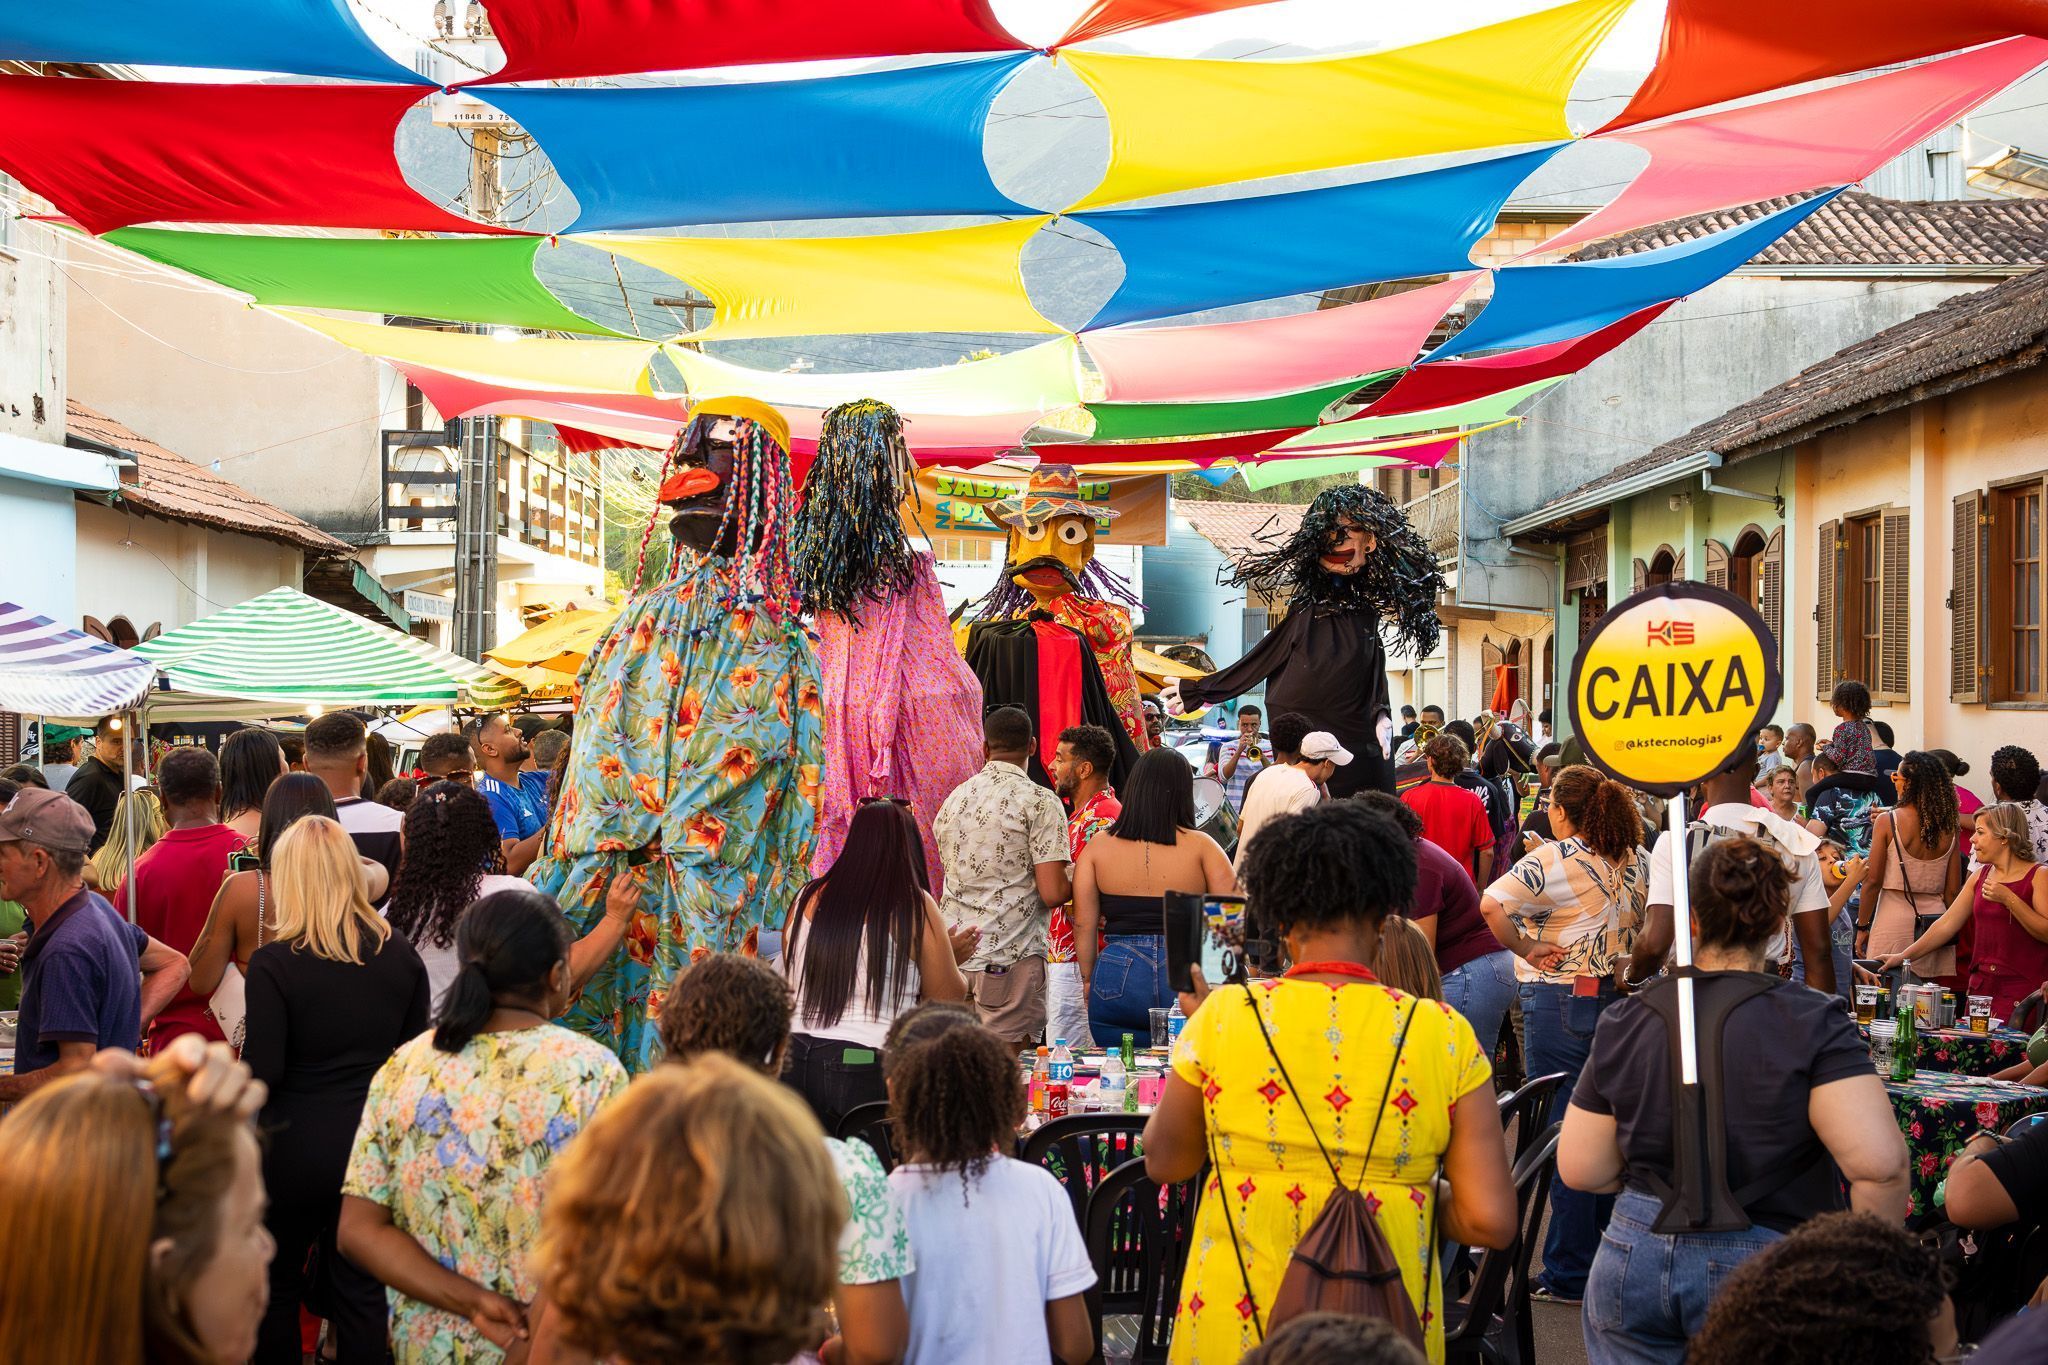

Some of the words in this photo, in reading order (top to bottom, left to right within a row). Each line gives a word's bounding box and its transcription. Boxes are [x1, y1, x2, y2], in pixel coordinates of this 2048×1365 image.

[936, 475, 1110, 501] SABAHO
[936, 502, 950, 529] NA
[1586, 654, 1755, 721] CAIXA
[1625, 734, 1723, 751] @kstecnologias
